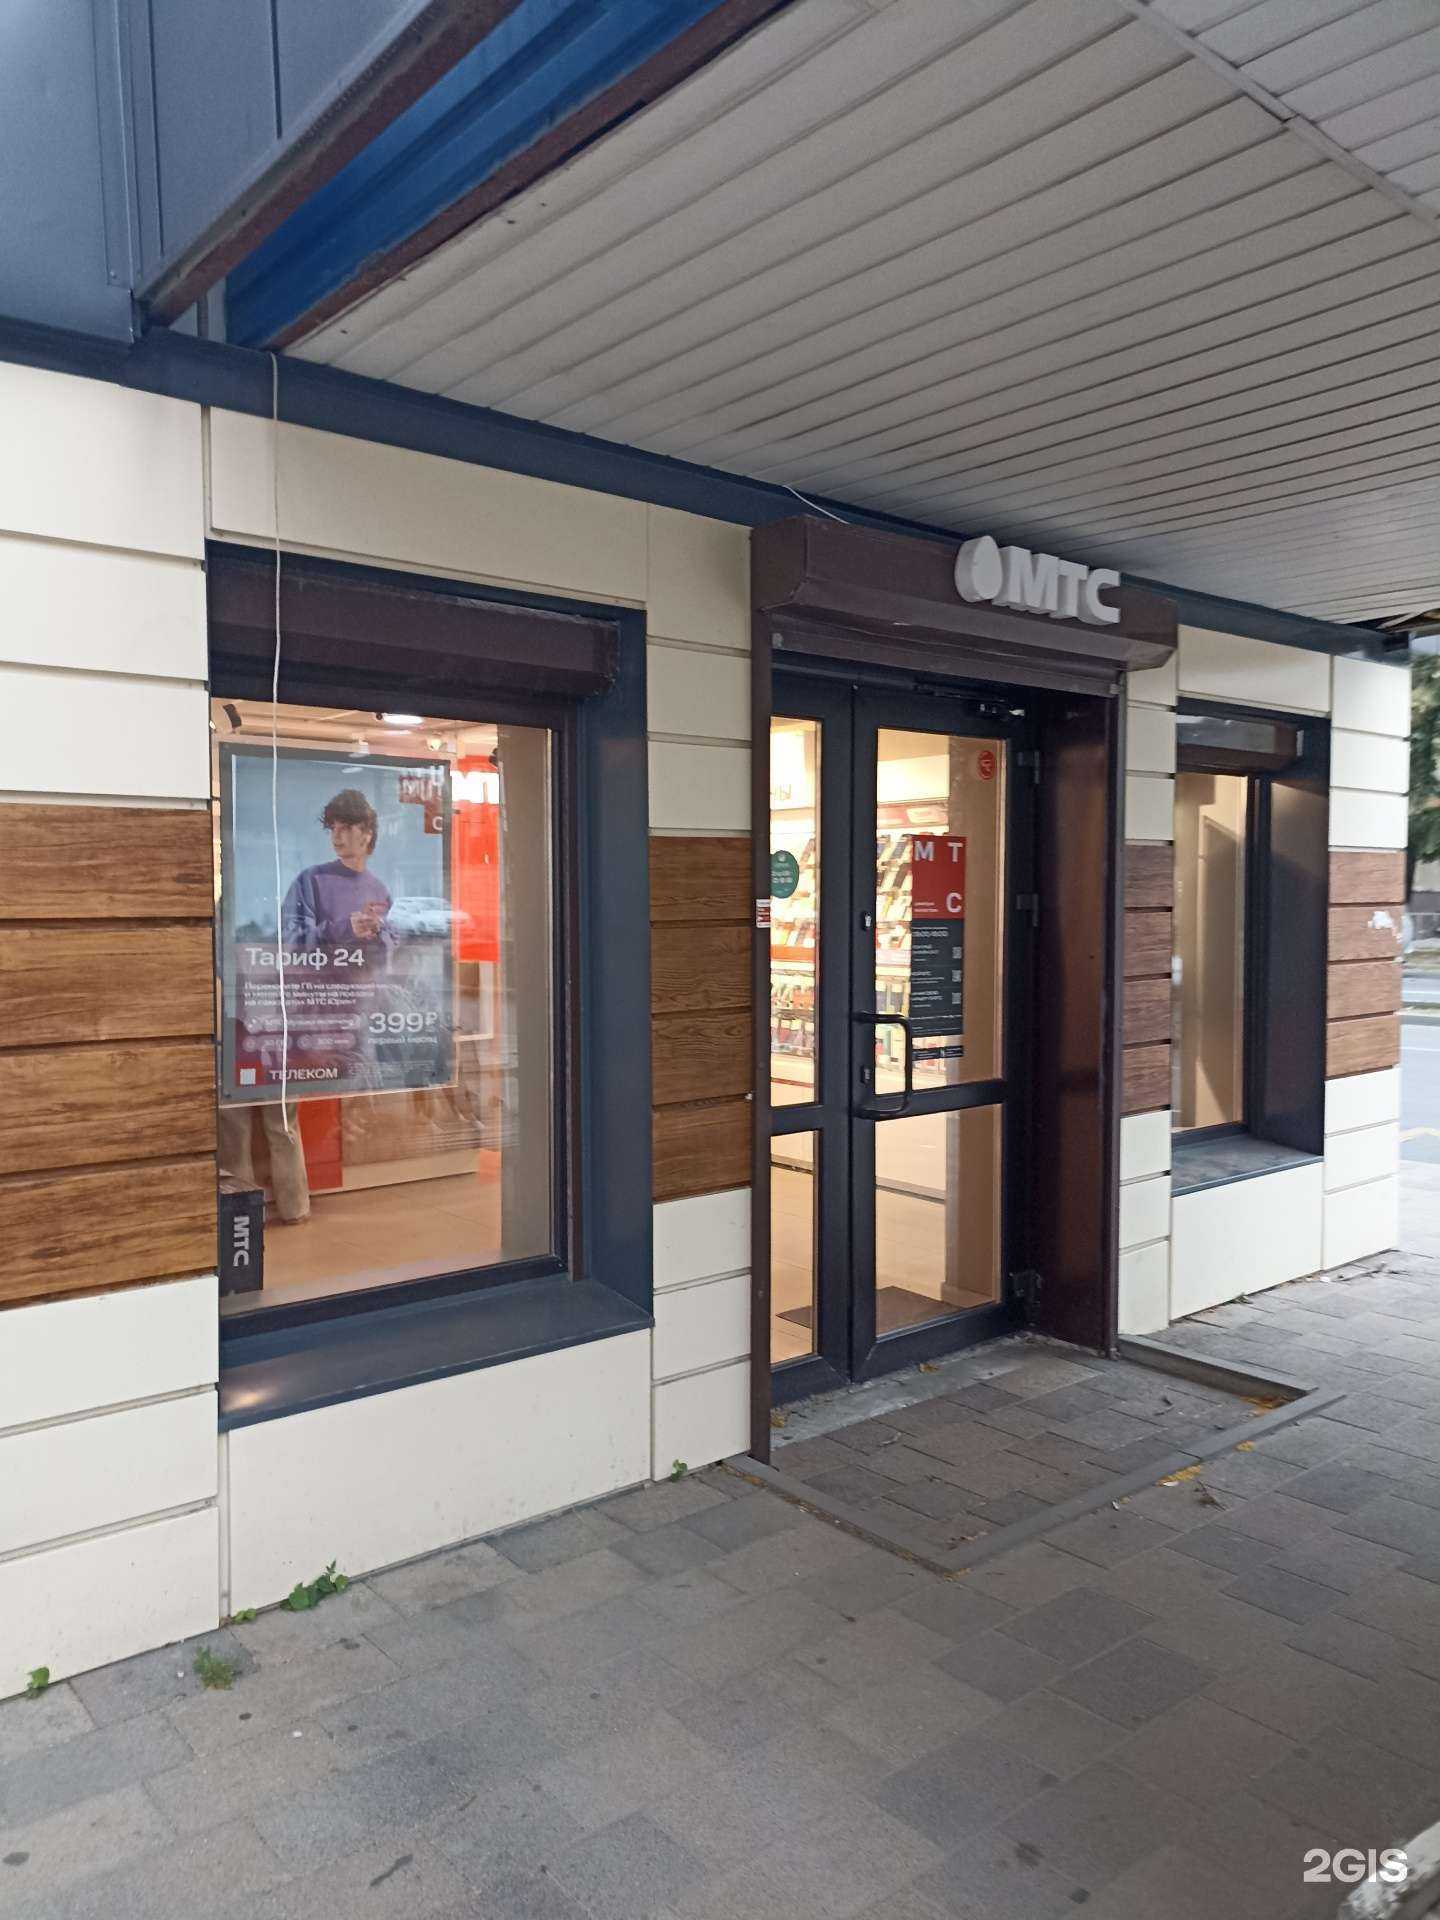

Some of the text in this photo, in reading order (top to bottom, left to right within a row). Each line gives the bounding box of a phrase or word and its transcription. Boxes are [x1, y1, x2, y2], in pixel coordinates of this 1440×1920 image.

[994, 545, 1121, 626] МТС
[245, 947, 365, 971] Тариф 24
[233, 1215, 250, 1267] МТС
